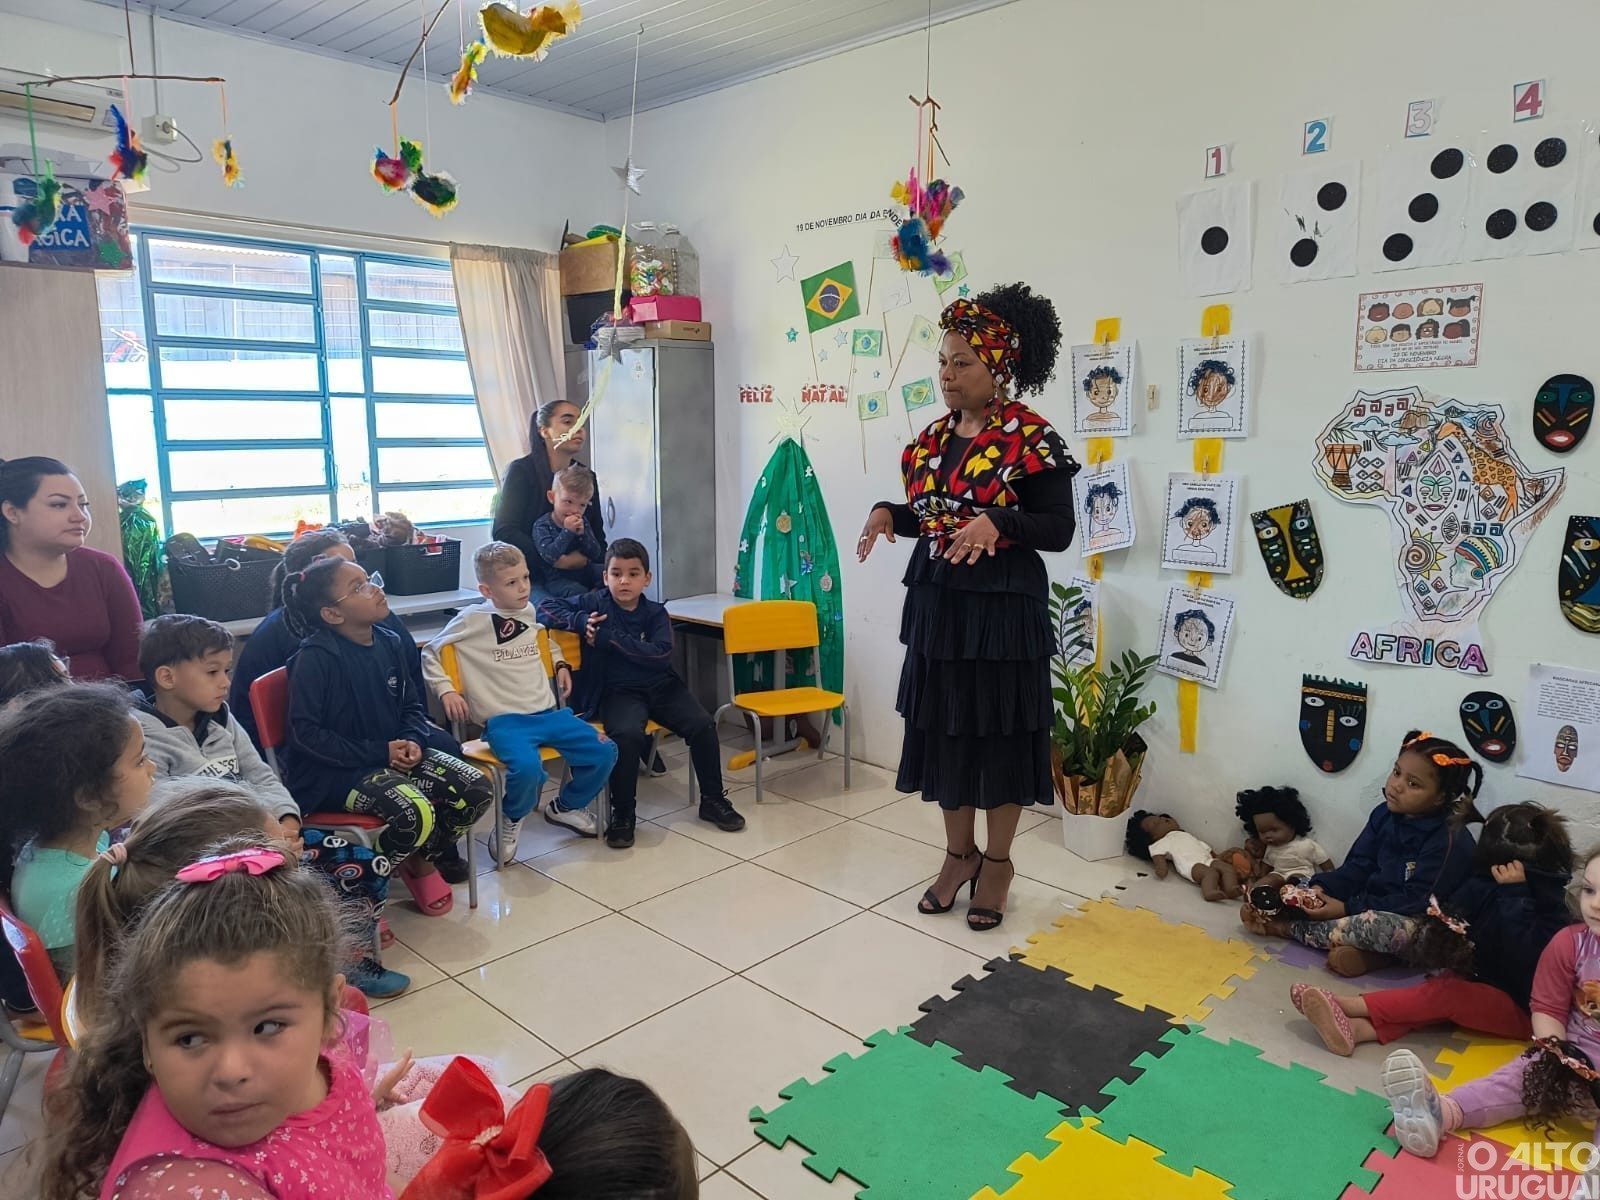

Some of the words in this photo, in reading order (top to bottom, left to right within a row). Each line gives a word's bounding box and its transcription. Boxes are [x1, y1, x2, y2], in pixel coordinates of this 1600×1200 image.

[1516, 82, 1542, 116] 4
[1409, 100, 1433, 135] 3
[1307, 121, 1326, 153] 2
[1211, 147, 1222, 175] 1
[805, 222, 815, 231] DE
[815, 215, 853, 229] NOVEMBRO
[855, 212, 867, 221] DIA
[870, 210, 881, 219] DA
[739, 385, 773, 403] FELIZ
[801, 384, 846, 403] NATAL
[1351, 632, 1488, 673] AFRICA
[432, 751, 483, 780] TRAINING
[384, 788, 410, 809] MILES
